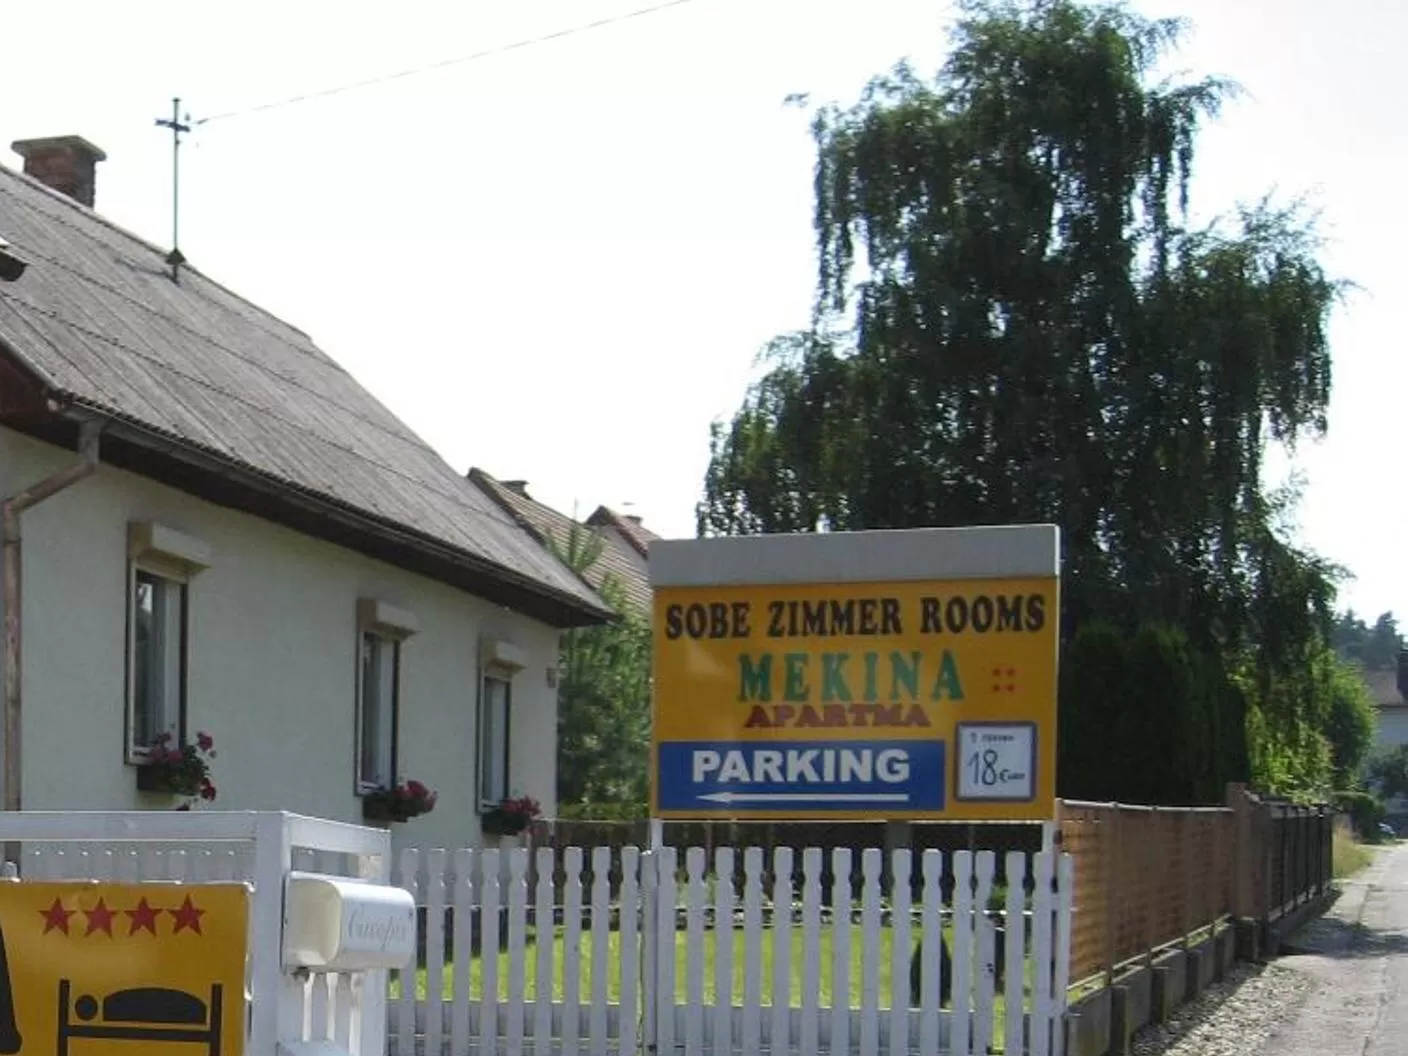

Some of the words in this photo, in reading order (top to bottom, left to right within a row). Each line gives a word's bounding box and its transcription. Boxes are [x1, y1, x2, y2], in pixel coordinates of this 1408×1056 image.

[665, 602, 751, 640] SOBE
[768, 598, 902, 638] ZIMMER
[920, 594, 1045, 635] ROOMS
[738, 649, 964, 702] MEKINA
[744, 703, 931, 728] APARTMA
[692, 749, 911, 783] PARKING
